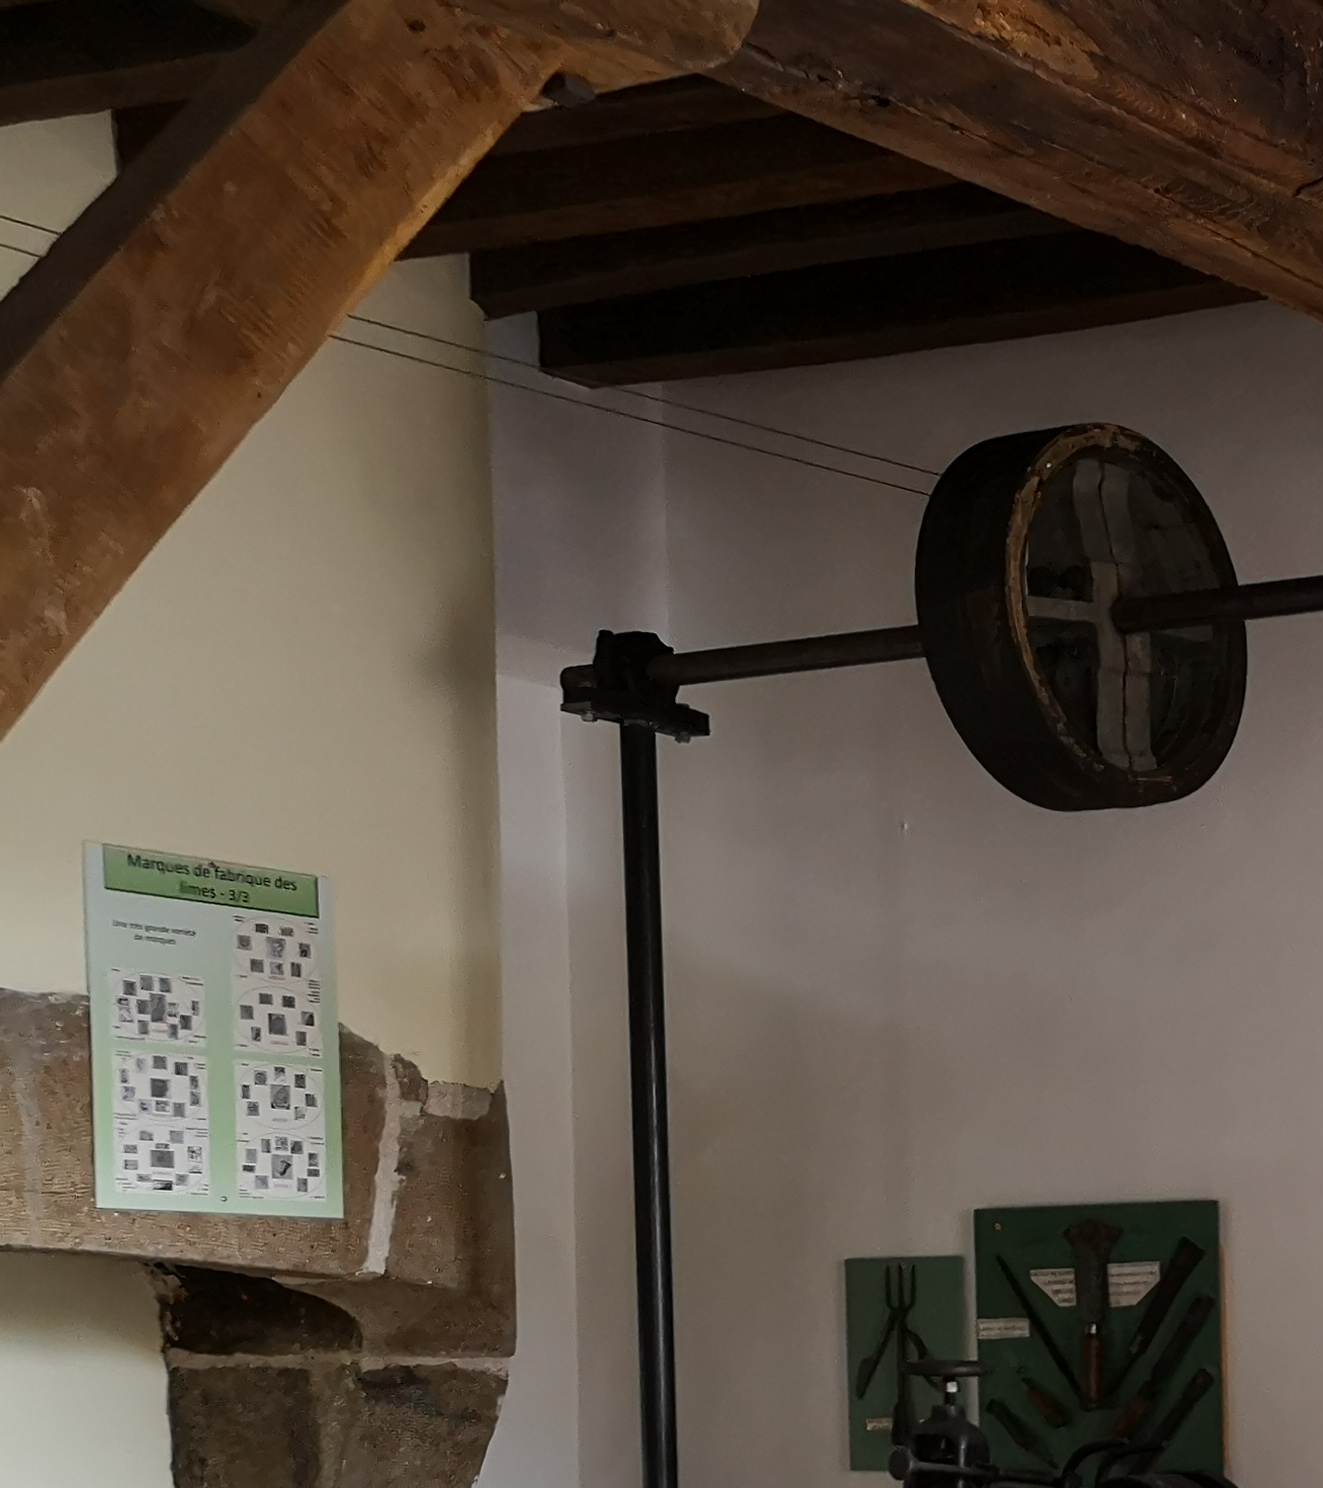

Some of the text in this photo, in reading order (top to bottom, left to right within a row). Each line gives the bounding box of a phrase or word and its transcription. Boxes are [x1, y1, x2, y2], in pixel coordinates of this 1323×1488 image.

[127, 853, 297, 892] Marques de fabrique des
[178, 879, 216, 899] limes
[229, 887, 250, 903] 3/3
